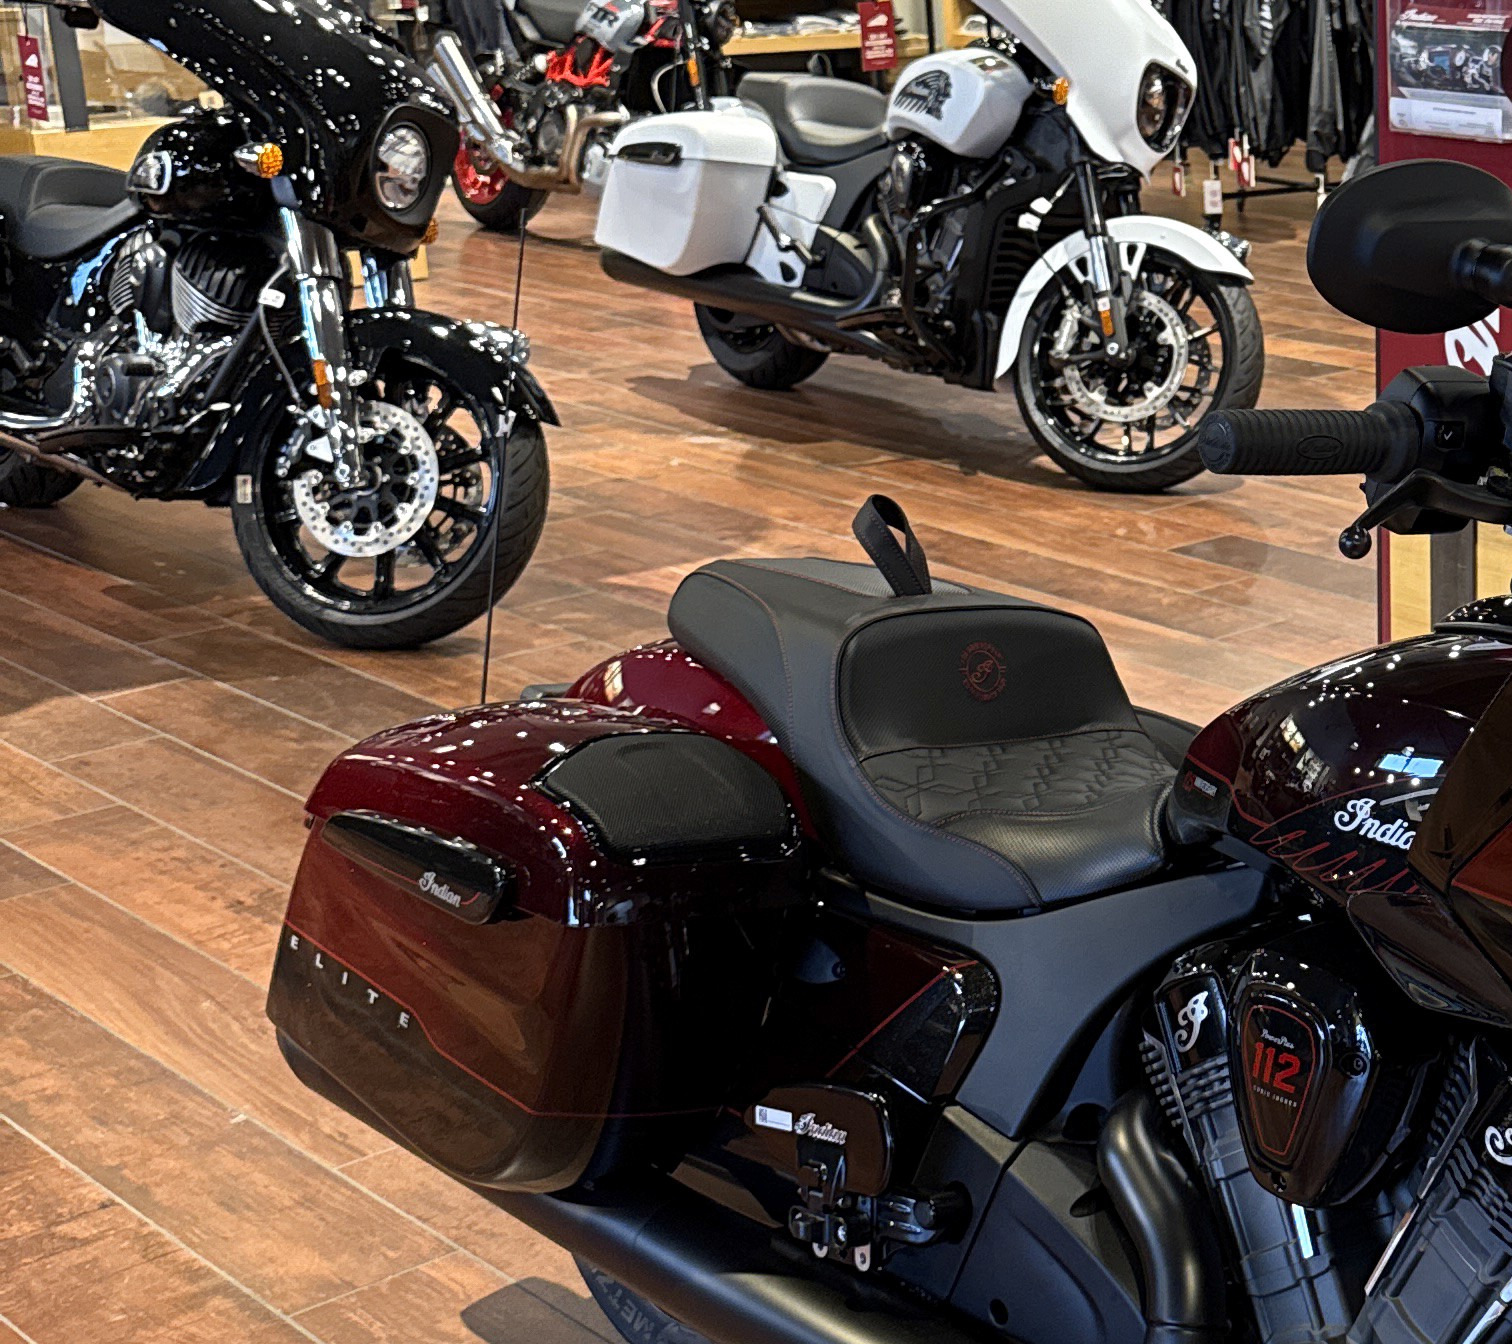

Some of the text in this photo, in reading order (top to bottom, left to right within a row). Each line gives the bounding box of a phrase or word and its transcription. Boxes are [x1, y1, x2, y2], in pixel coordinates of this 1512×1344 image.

[1333, 797, 1417, 851] India
[418, 870, 462, 908] Indian
[289, 934, 411, 1029] ELITE
[1252, 1041, 1301, 1095] 112
[794, 1112, 848, 1146] Indian
